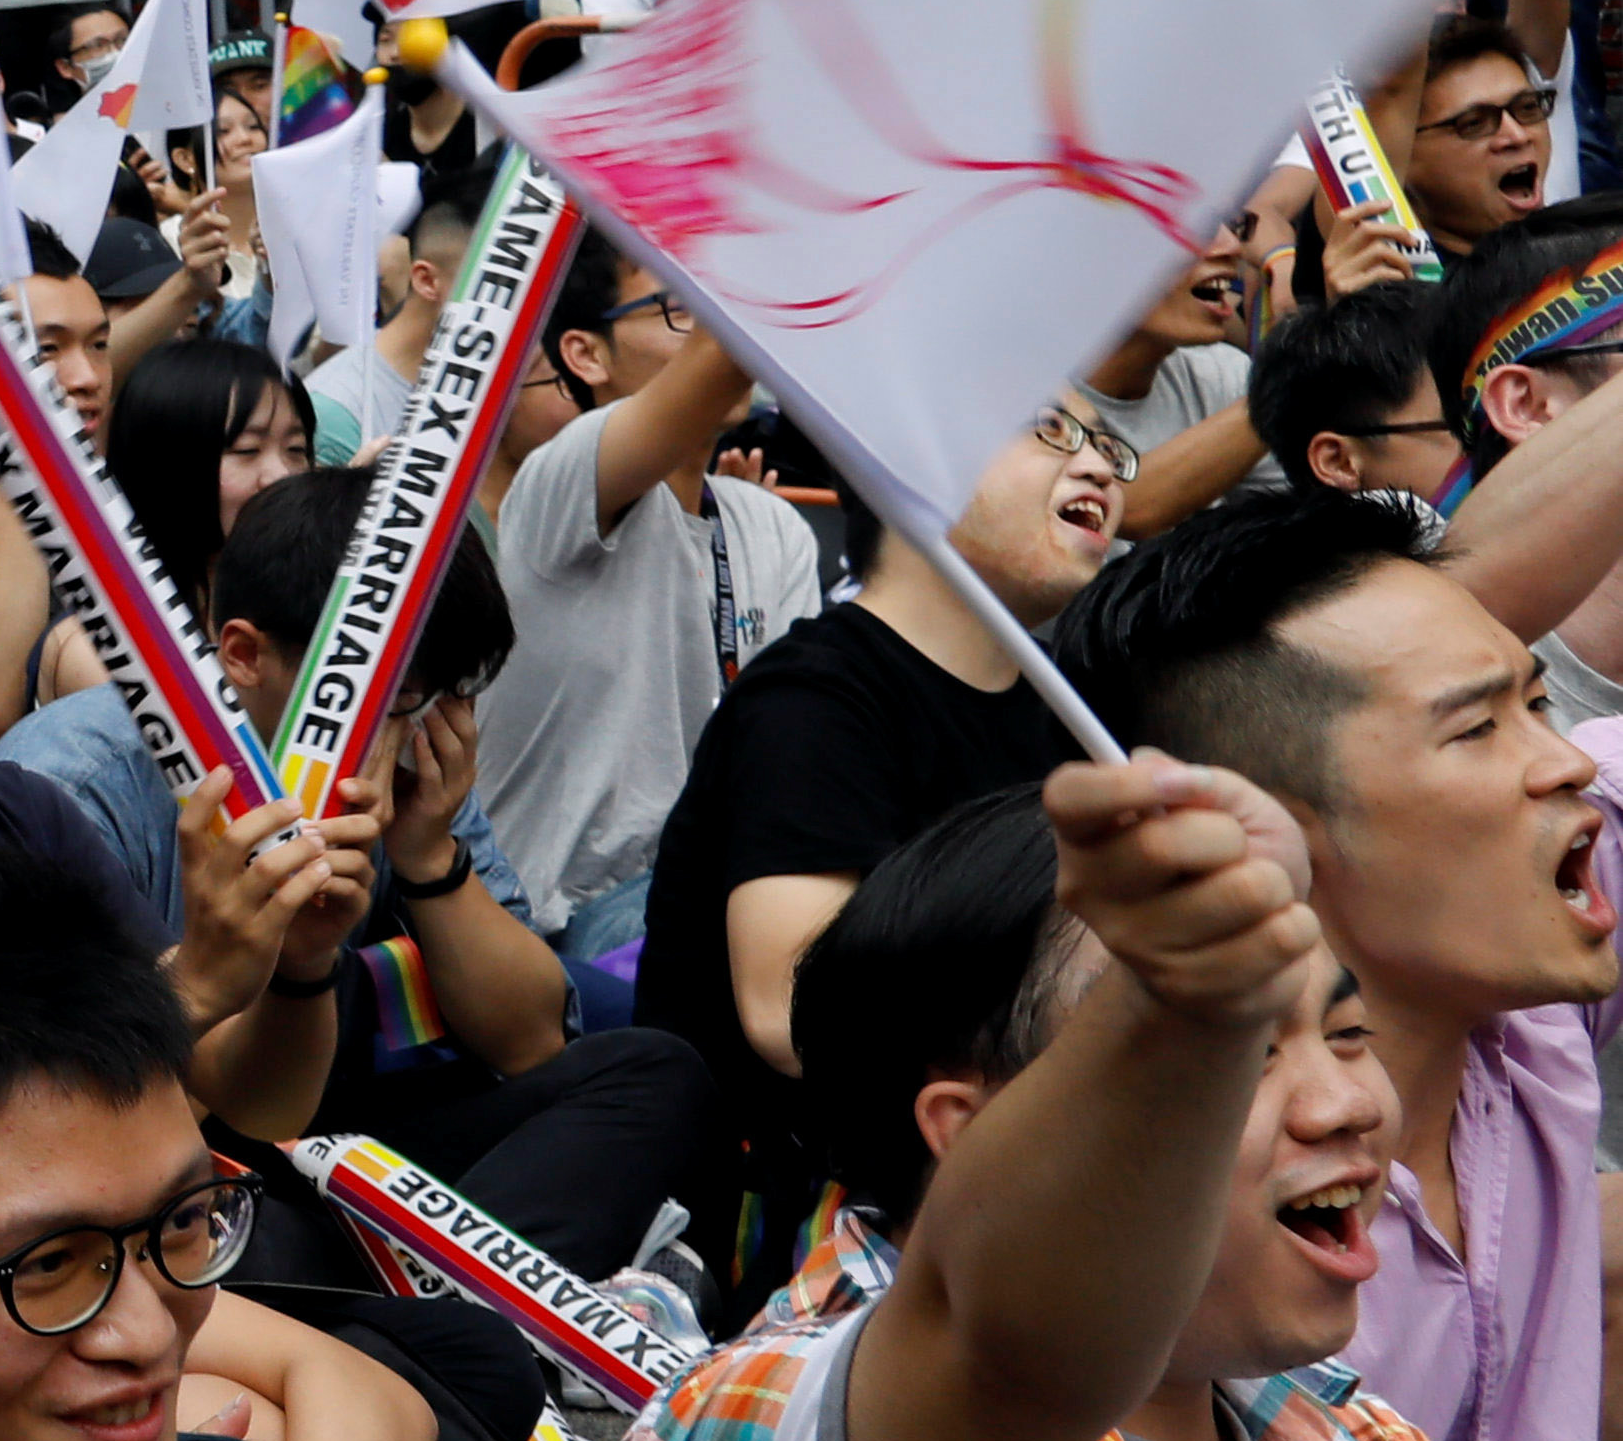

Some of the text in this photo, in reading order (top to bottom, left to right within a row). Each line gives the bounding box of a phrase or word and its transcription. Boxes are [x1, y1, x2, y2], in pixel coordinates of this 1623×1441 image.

[1339, 149, 1374, 175] U
[15, 488, 198, 794] MARRIAGE
[295, 446, 448, 756] MARRIAGE
[719, 599, 737, 654] TAIWAN
[388, 1169, 627, 1341] MARRIAGE
